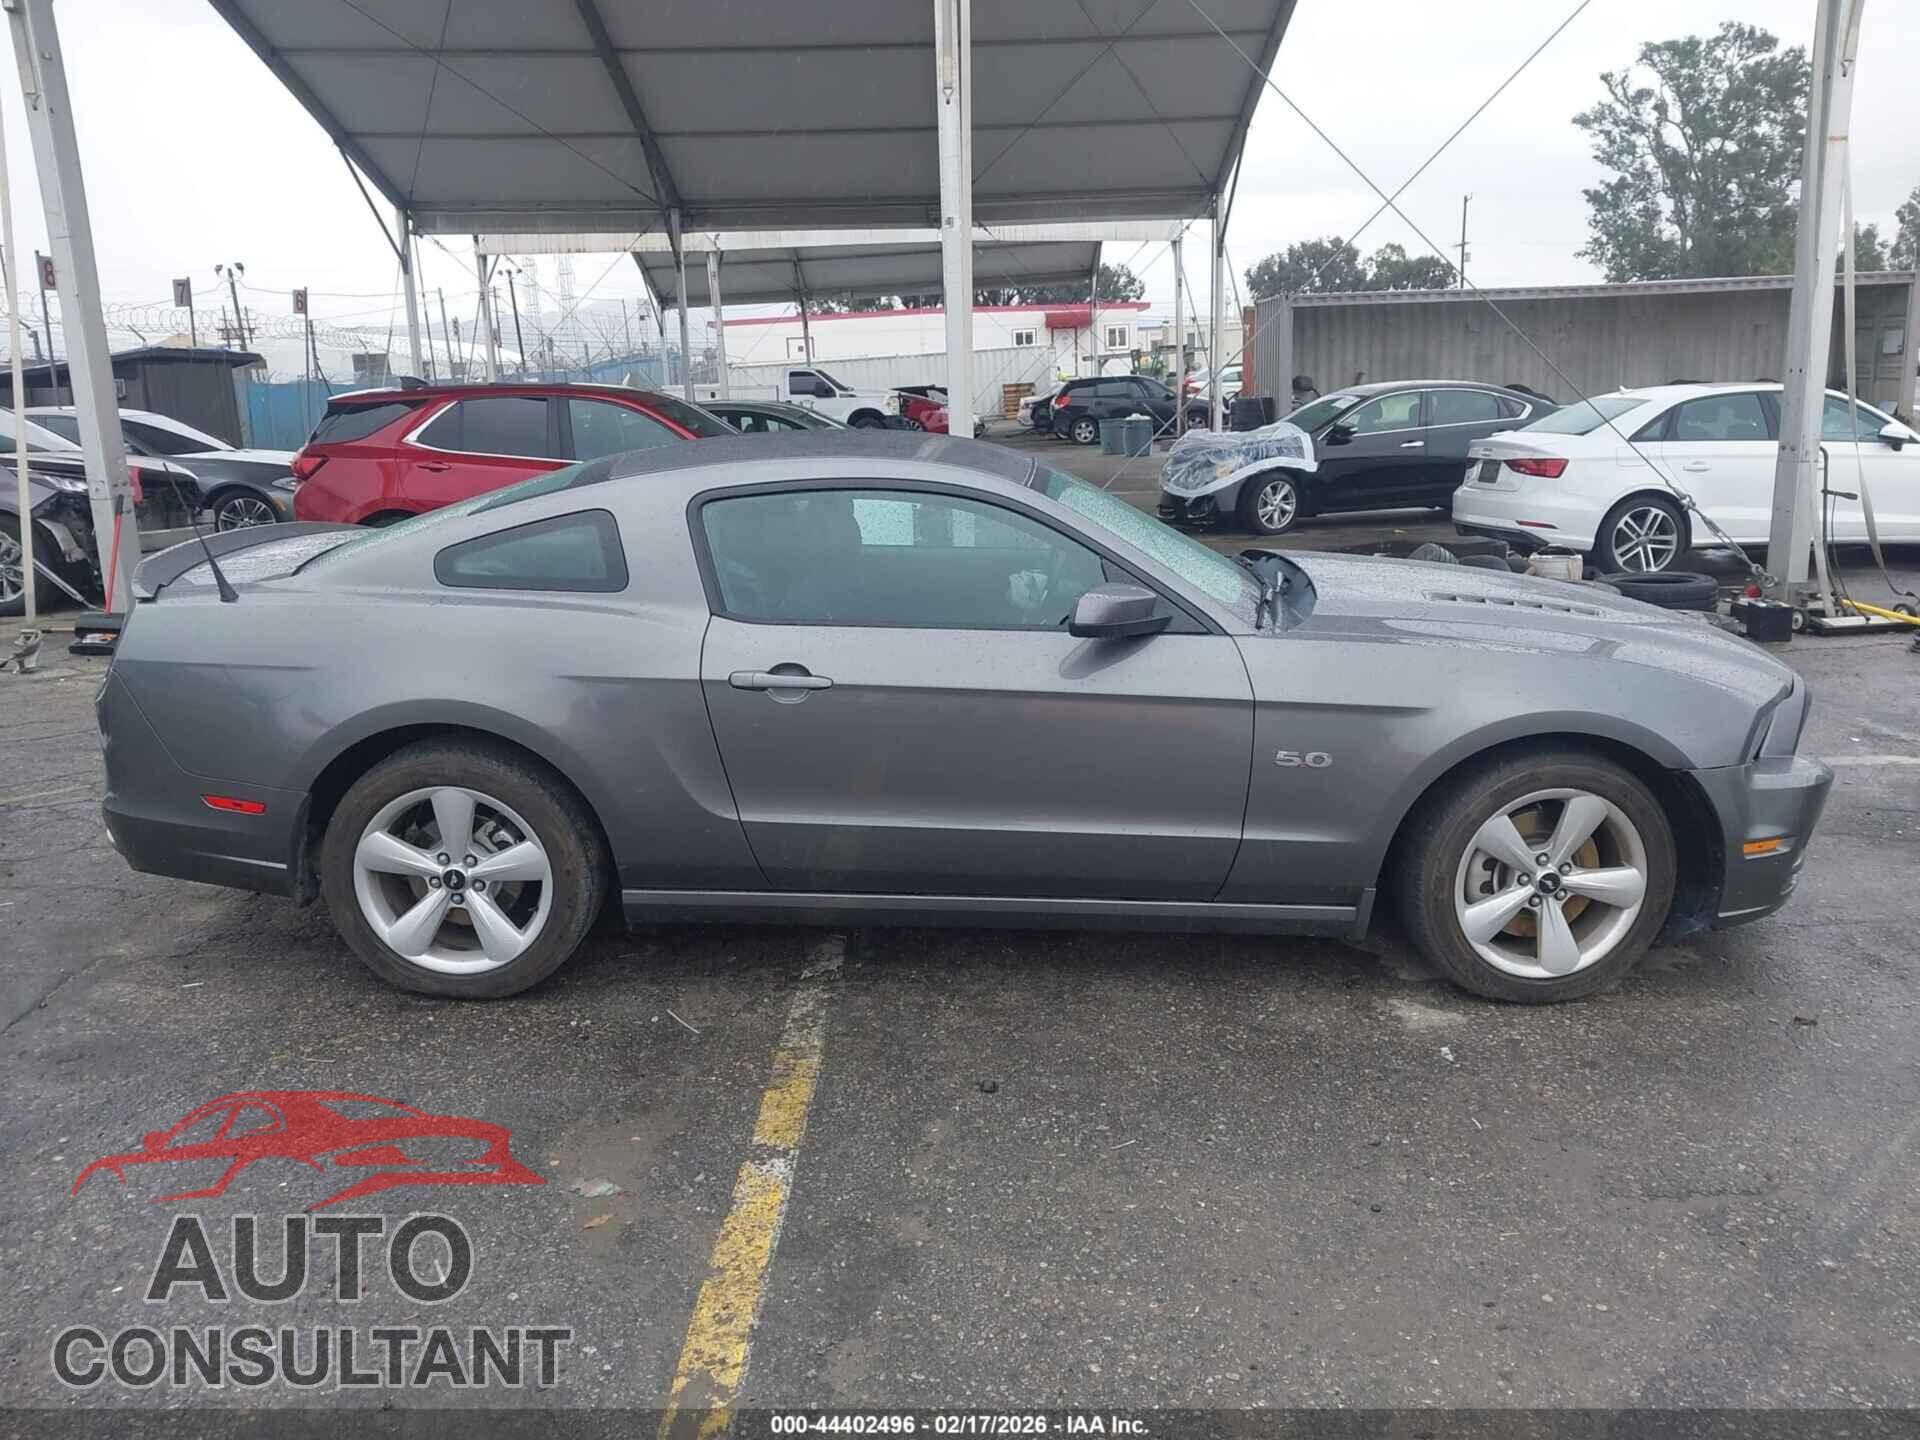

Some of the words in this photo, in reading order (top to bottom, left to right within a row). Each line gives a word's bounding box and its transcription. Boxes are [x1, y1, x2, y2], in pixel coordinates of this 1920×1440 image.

[44, 260, 56, 287] 8
[176, 282, 186, 305] 7
[296, 292, 304, 311] 6
[1274, 750, 1333, 768] 5.0
